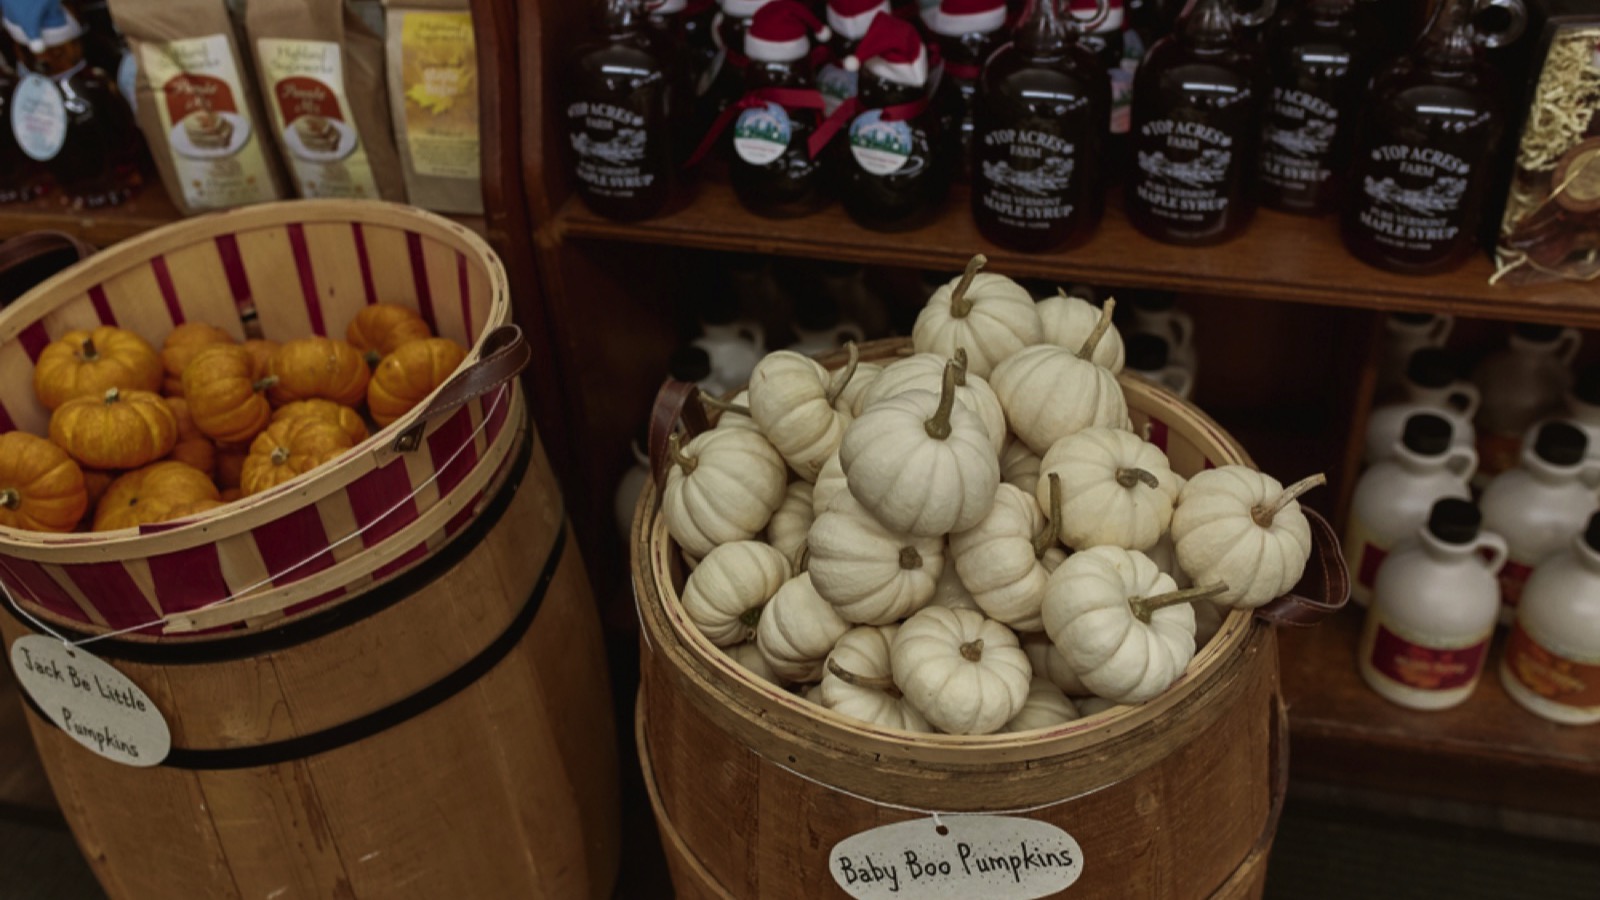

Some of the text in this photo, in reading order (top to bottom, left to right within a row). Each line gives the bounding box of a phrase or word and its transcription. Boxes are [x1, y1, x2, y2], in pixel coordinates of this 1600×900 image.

[991, 128, 1064, 152] TOP ACRES
[1149, 119, 1223, 144] TOP ACRES
[1166, 135, 1199, 150] FARM
[1009, 144, 1042, 159] FARM
[1379, 144, 1462, 172] TOP ACRES
[609, 174, 654, 188] SYRUP
[1399, 161, 1436, 178] FARM
[983, 194, 1074, 219] MAPLE SYRUP
[1137, 185, 1228, 212] MAPLE SYRUP
[1359, 210, 1459, 240] MAPLE SYRUP
[20, 647, 147, 712] Jack Be Little
[61, 706, 139, 757] Pumpkins
[839, 842, 1073, 892] Baby Boo Pumpkins
